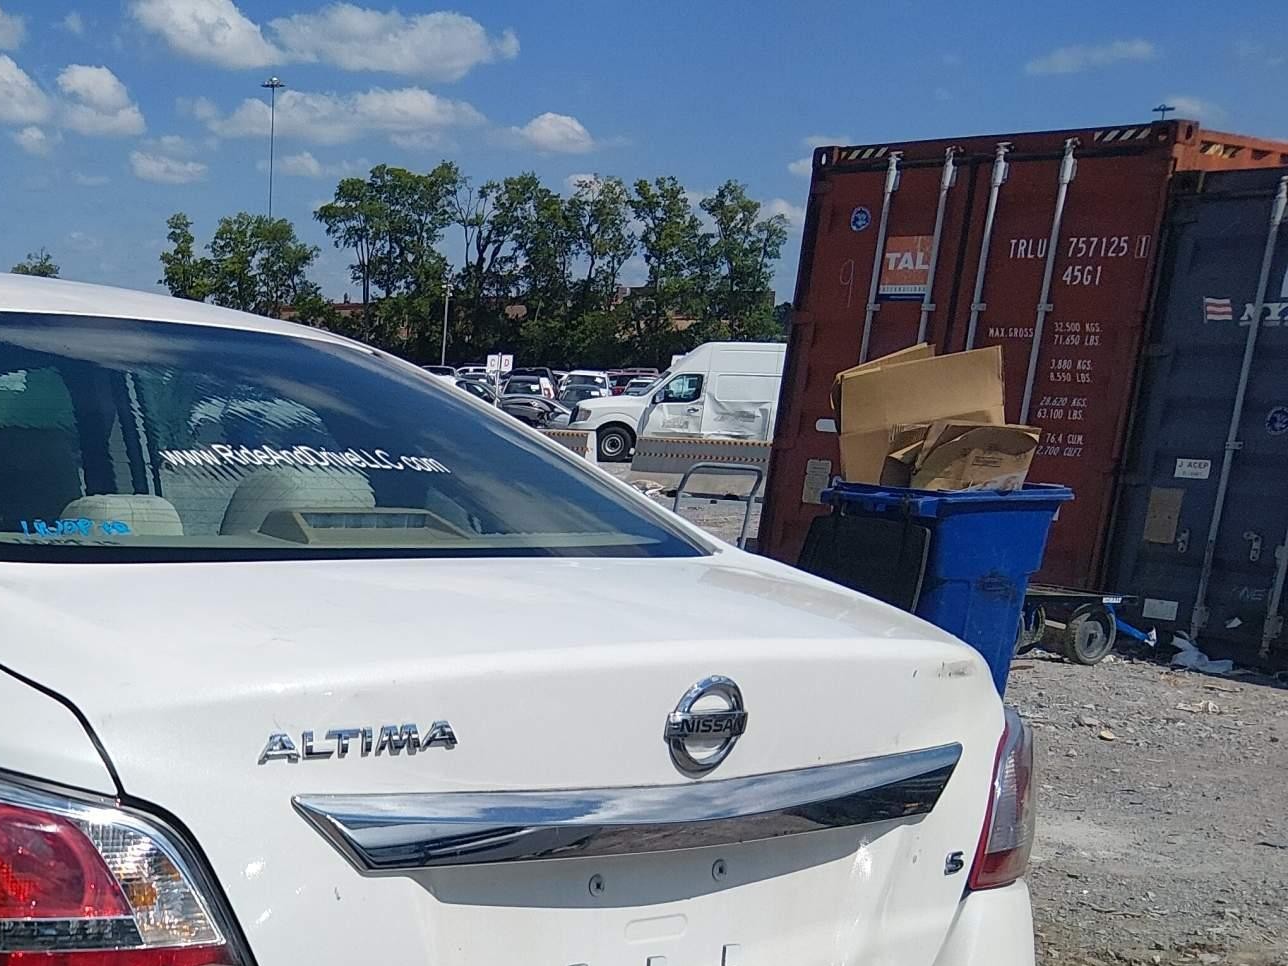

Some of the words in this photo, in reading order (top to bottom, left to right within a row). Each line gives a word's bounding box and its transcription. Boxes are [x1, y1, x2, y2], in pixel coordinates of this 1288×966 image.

[1009, 238, 1048, 258] TRLU
[1068, 236, 1129, 257] 757125
[885, 251, 930, 271] TAL
[1062, 266, 1102, 285] 45G1
[1053, 322, 1081, 332] 32.500
[1053, 334, 1081, 345] 71.650
[159, 443, 452, 474] www.RideAndDriveLLC.com
[680, 717, 744, 734] NISSAN
[257, 719, 460, 766] ALTIMA
[943, 850, 965, 876] S
